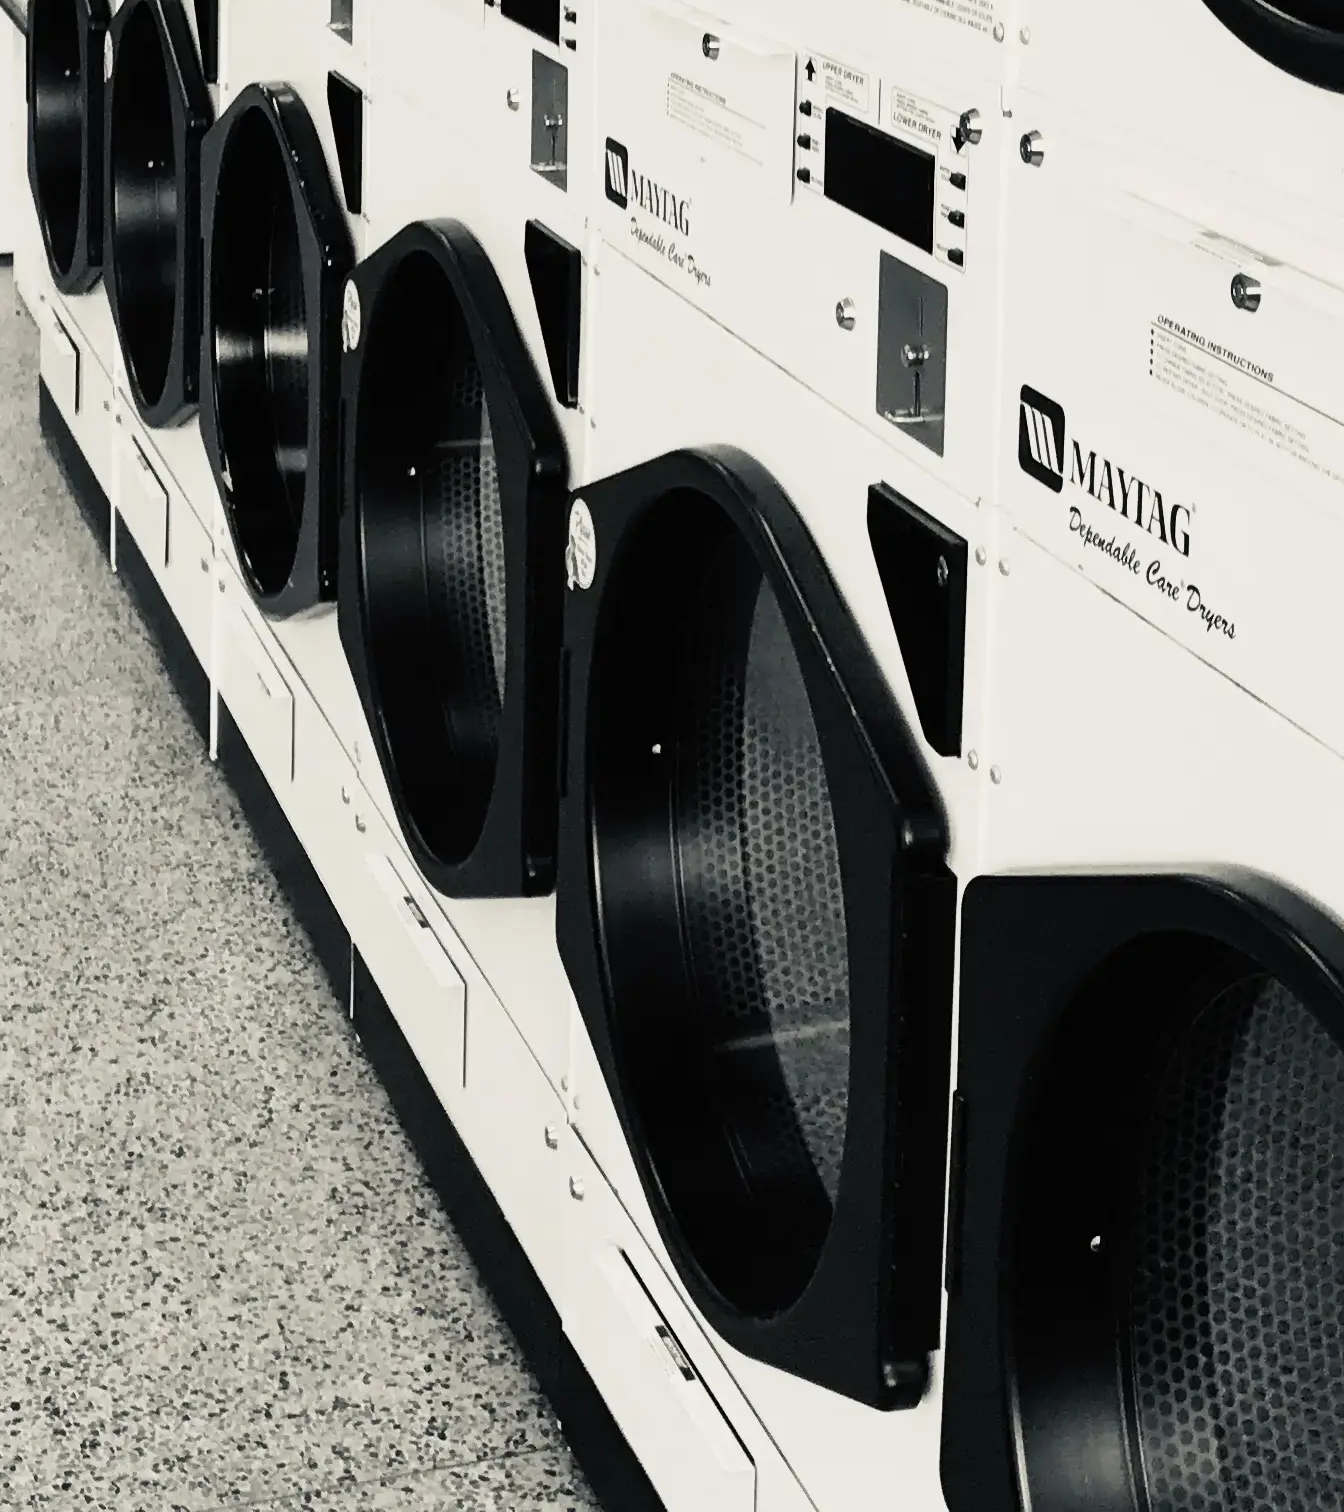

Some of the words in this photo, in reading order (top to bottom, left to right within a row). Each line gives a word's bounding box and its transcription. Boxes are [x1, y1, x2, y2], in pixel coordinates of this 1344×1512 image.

[822, 61, 843, 76] UPPER
[843, 69, 864, 86] DRYER
[893, 112, 917, 130] LOWER
[918, 123, 942, 140] DRYER
[631, 169, 690, 236] MAYTAG
[631, 216, 666, 256] Dependable
[668, 243, 684, 268] Care
[688, 254, 710, 287] Dryers
[1157, 314, 1206, 346] OPERATING
[1207, 340, 1274, 382] INSTRUCTIONS
[1069, 438, 1191, 558] MAYTAG
[1069, 506, 1141, 575] Dependable
[1146, 560, 1181, 602] Care
[1186, 584, 1236, 639] Dryers
